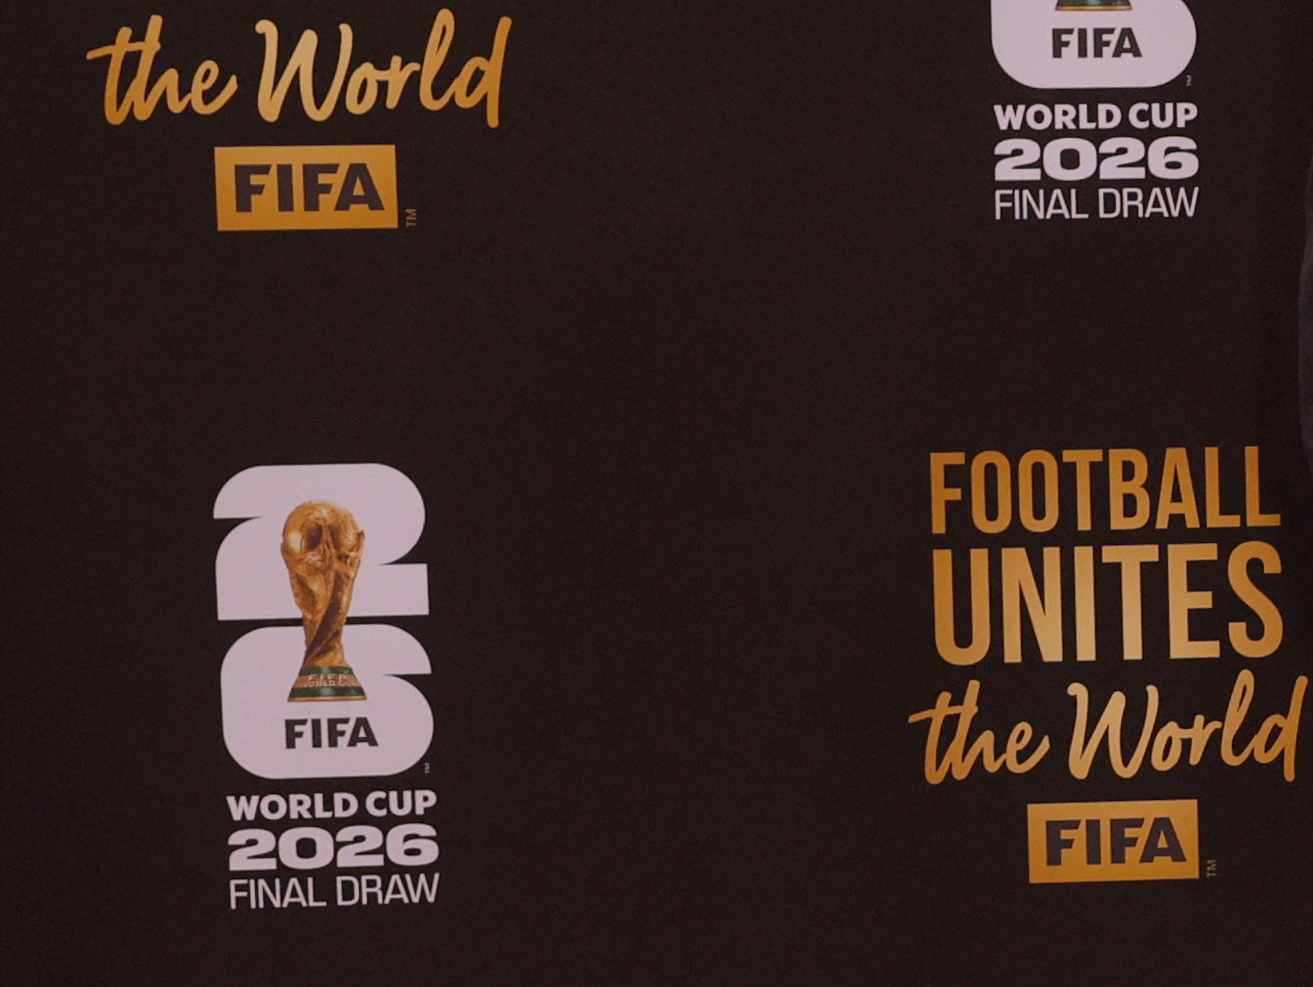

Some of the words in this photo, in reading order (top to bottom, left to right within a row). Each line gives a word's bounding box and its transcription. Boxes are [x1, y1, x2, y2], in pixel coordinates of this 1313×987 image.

[1052, 28, 1142, 58] FIFA
[87, 15, 238, 124] the
[255, 9, 512, 128] World
[994, 104, 1121, 130] WORLD
[1129, 103, 1197, 128] CUP
[995, 136, 1198, 180] 2026
[235, 163, 384, 212] FIFA
[995, 189, 1089, 219] FINAL
[1099, 187, 1199, 218] DRAW
[930, 446, 1280, 534] FOOTBALL
[933, 541, 1283, 665] UNITES
[285, 717, 378, 749] FIFA
[909, 680, 1050, 784] the
[1067, 669, 1308, 781] World
[227, 793, 358, 820] WORLD
[366, 790, 436, 816] CUP
[228, 824, 438, 870] 2026
[1046, 817, 1186, 866] FIFA
[230, 877, 326, 909] FINAL
[336, 873, 439, 905] DRAW
